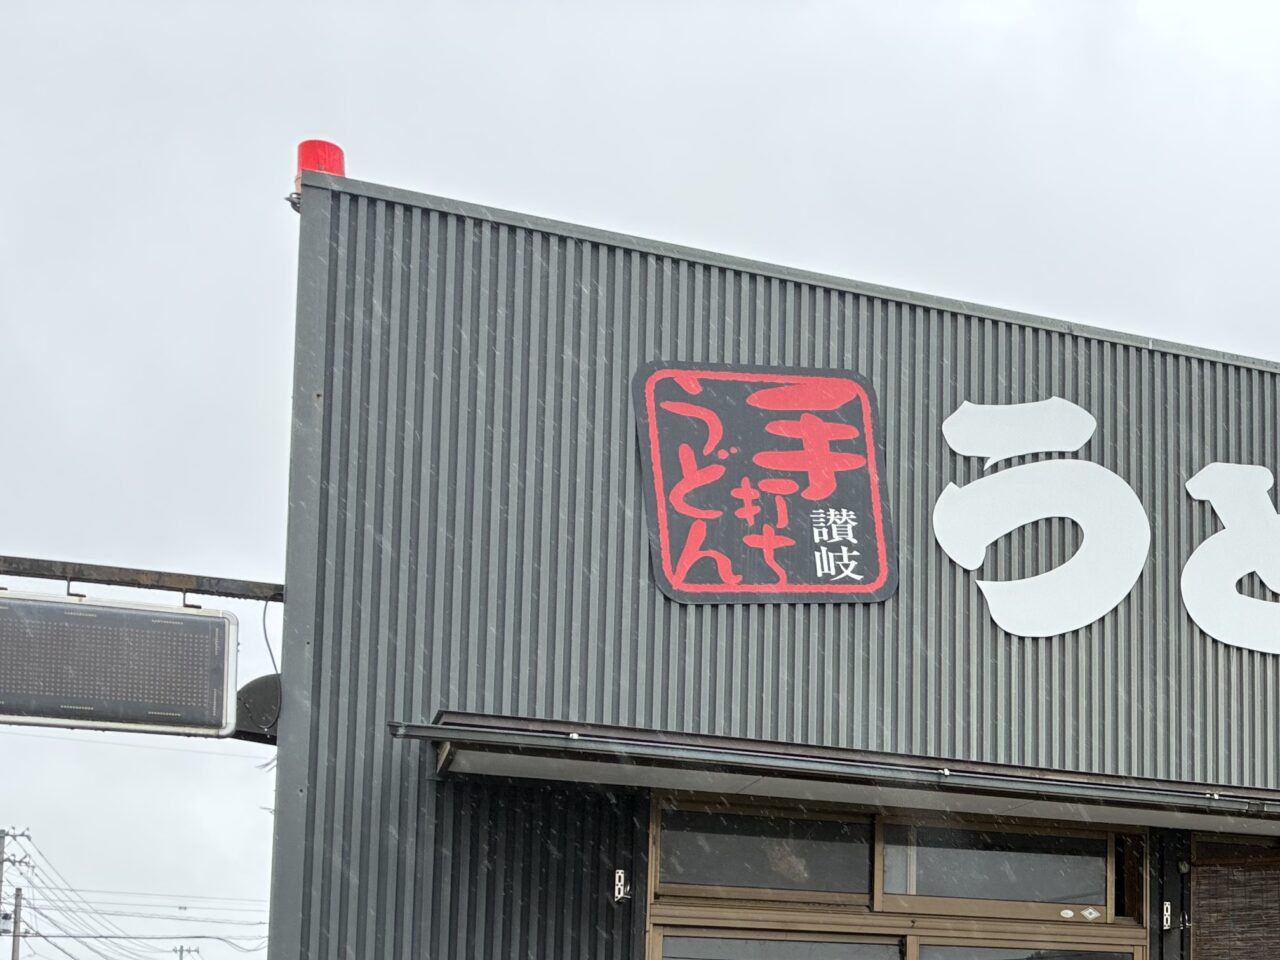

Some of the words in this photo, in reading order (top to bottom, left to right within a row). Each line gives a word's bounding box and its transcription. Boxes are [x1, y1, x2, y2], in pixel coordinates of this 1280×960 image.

[660, 376, 738, 585] うどん
[810, 508, 864, 581] 讃岐
